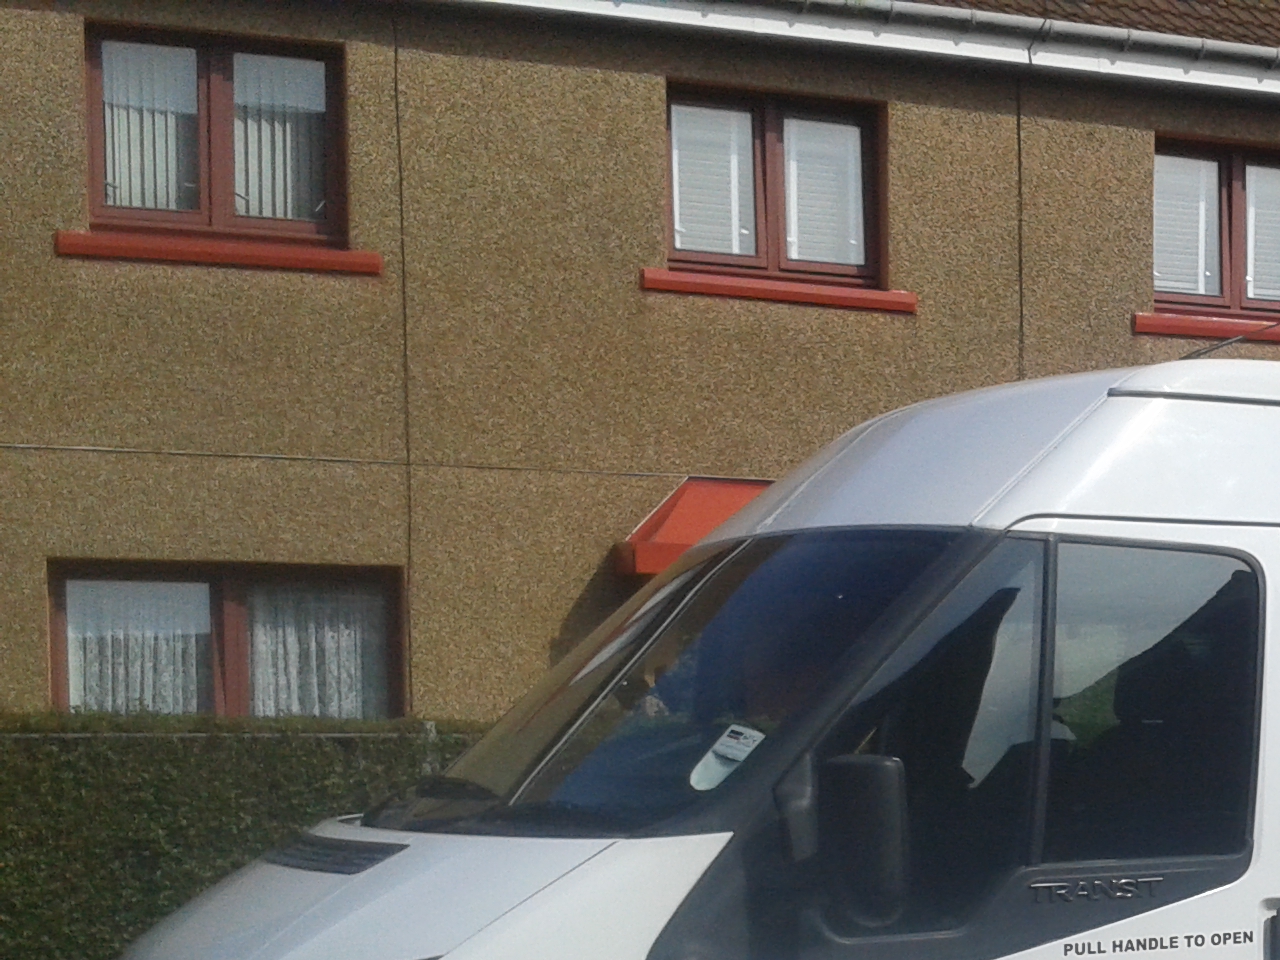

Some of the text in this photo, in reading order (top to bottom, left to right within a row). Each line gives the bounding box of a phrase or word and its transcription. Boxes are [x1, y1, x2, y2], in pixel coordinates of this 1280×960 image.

[1063, 931, 1254, 956] PULL HANDLE TO OPEN
